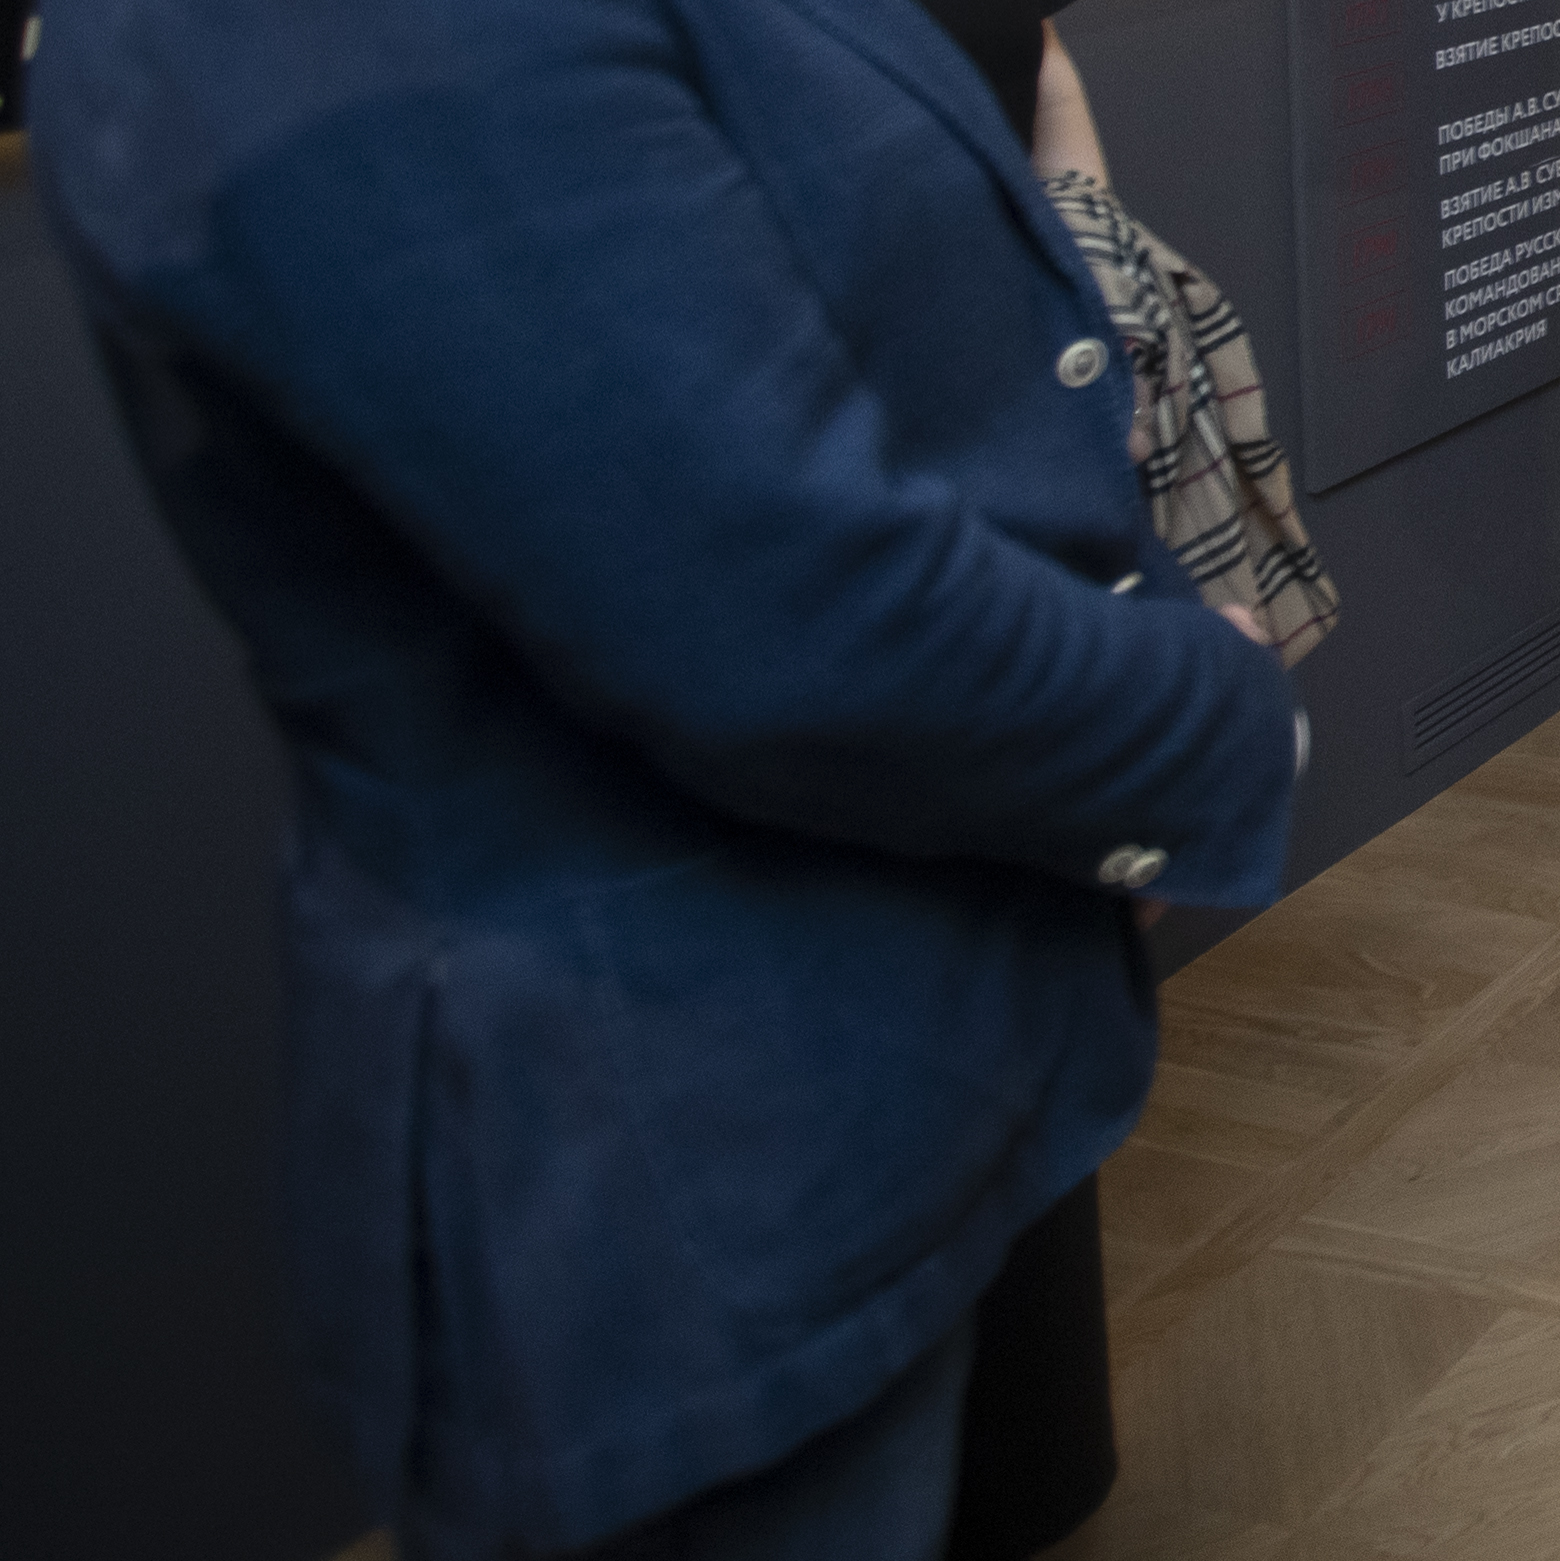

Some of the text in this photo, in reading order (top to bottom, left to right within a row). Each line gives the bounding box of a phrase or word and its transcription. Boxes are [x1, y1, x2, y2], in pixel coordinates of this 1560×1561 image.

[1435, 2, 1448, 23] У
[1435, 35, 1499, 70] ВЗЯТИЕ
[1438, 106, 1509, 145] ПОБЕДЫ
[1440, 146, 1476, 175] ПРИ
[1441, 180, 1504, 219] ВЗЯТИЕ
[1442, 200, 1529, 249] КРЕПОСТИ
[1444, 248, 1512, 291] ПОБЕДА
[1446, 329, 1458, 350] В
[1460, 293, 1544, 342] МОРСКОМ
[1447, 318, 1548, 379] КАЛИАКРИЯ
